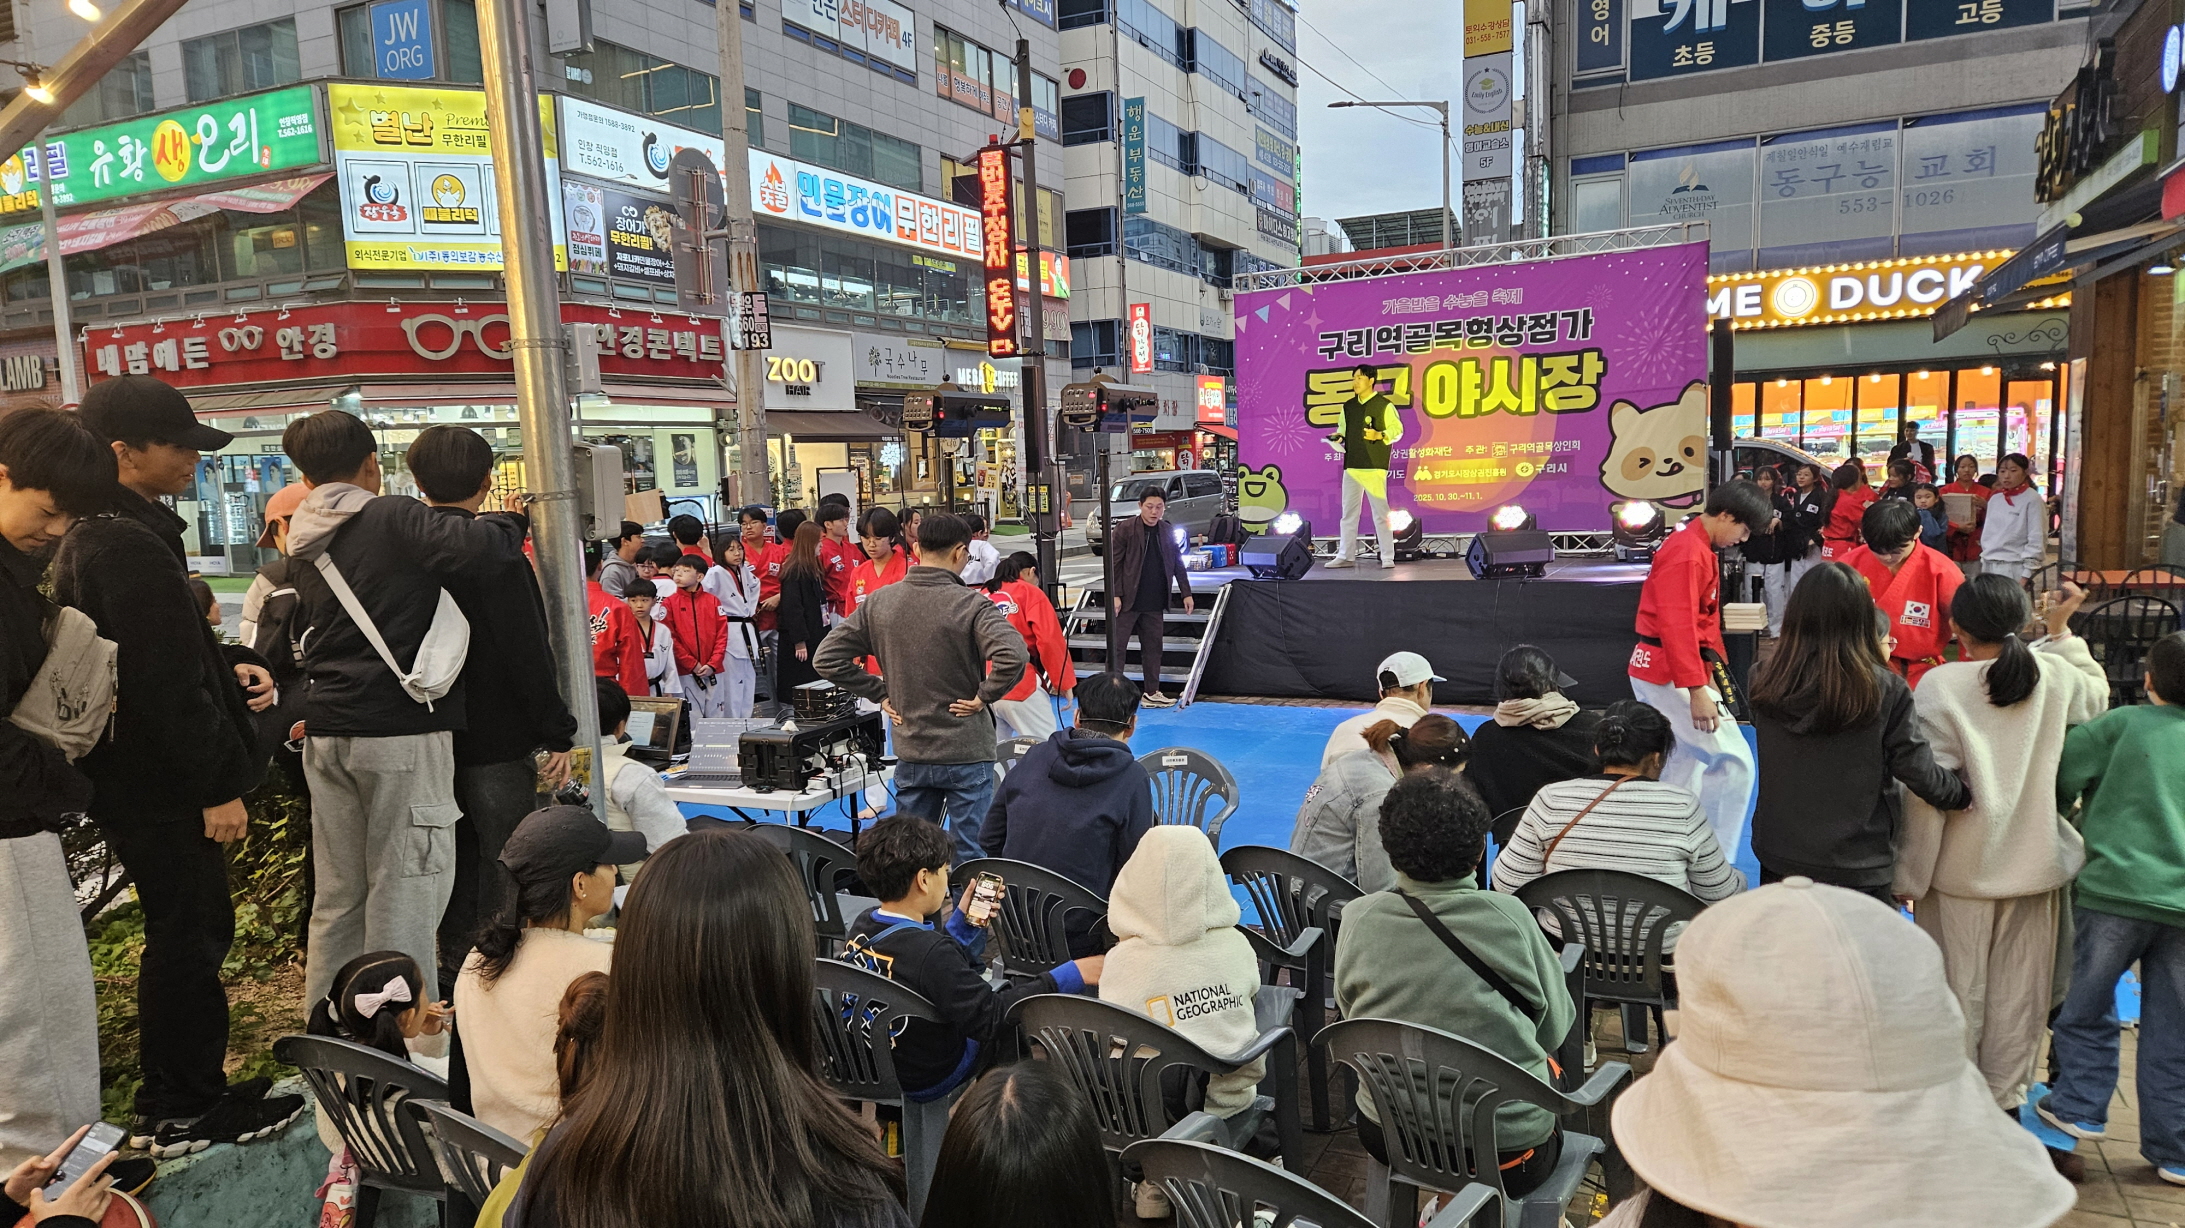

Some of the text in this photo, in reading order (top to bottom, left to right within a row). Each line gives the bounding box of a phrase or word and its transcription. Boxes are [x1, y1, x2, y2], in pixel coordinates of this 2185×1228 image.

[1955, 0, 2003, 26] 고등
[384, 8, 418, 45] JW
[1465, 19, 1510, 34] 토익수강상담
[1809, 20, 1856, 48] 중등
[901, 31, 912, 48] 4F
[384, 45, 423, 72] .ORG
[1672, 41, 1716, 67] 초등
[369, 110, 433, 146] 별난
[1464, 120, 1510, 137] 수능&내신
[442, 134, 487, 148] 무한리필
[1126, 104, 1143, 199] 행운부동산
[1464, 138, 1509, 153] 영어교습소
[579, 153, 624, 173] T.562-1616
[1480, 157, 1493, 168] 5F
[1770, 159, 1889, 199] 동구능
[797, 170, 892, 234] 민물장어
[897, 197, 982, 255] 무한리필
[1659, 200, 1719, 215] ADVENTIST
[616, 216, 647, 235] 장어가
[610, 230, 653, 250] 무한리필!
[354, 249, 407, 261] 외식전문기업
[1831, 264, 1984, 310] DUCK
[1382, 296, 1440, 315] 가을밤을
[1491, 288, 1523, 305] 축제
[275, 322, 338, 360] 안경
[595, 323, 724, 362] 안경콘택트
[1317, 307, 1595, 361] 구리역골목형상점가
[885, 347, 928, 375] 국수나무
[957, 367, 1018, 387] MEGA COFFEE
[1422, 347, 1607, 418] 야시장
[1509, 439, 1581, 455] 구리역골목상인회
[1535, 462, 1568, 475] 구리시
[1173, 983, 1231, 1007] NATIONAL
[1176, 995, 1243, 1020] GEOGRAPHIC
